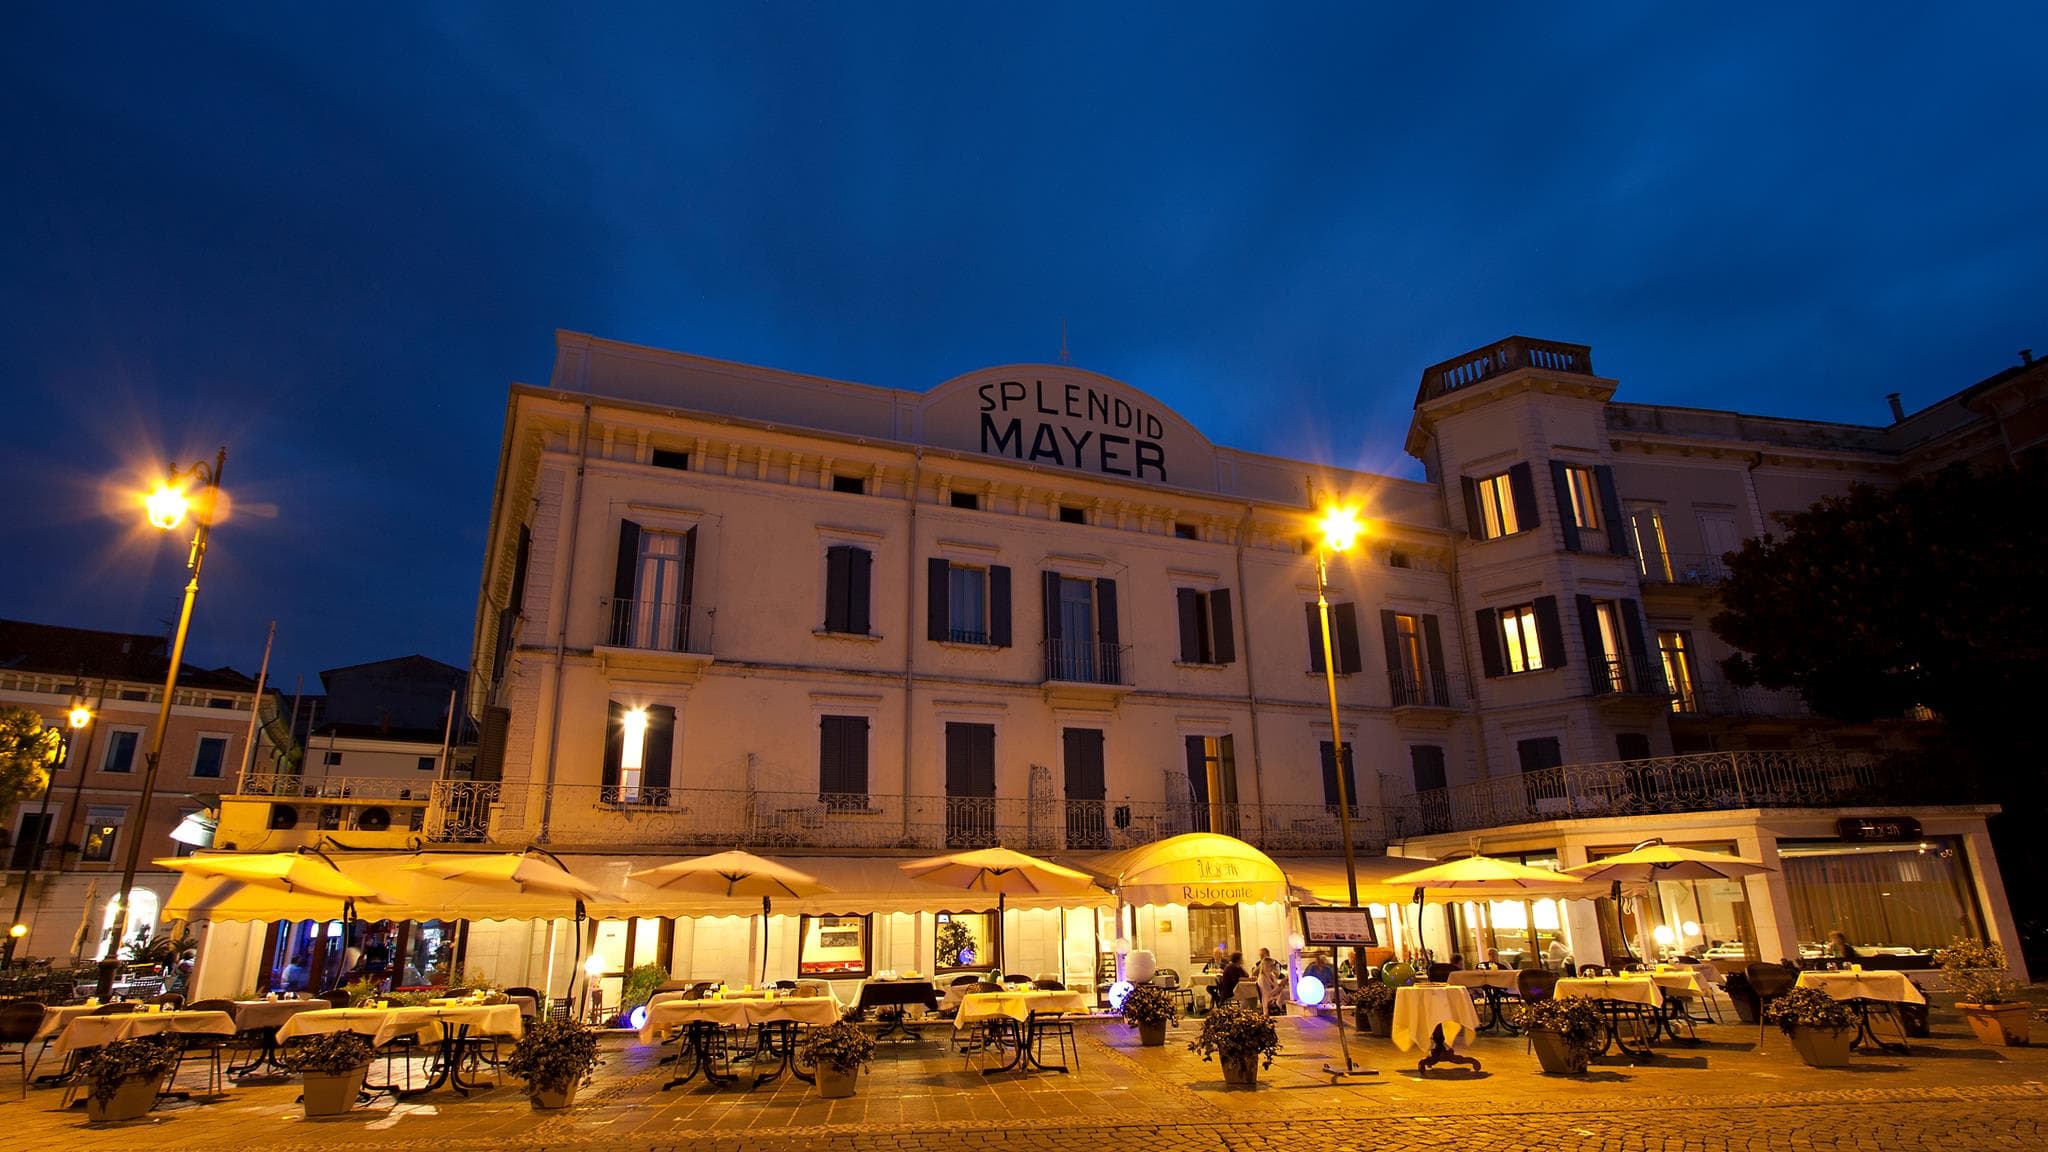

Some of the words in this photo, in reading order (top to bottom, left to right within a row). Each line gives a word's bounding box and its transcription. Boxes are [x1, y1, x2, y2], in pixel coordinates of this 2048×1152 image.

[978, 380, 1163, 440] SPLENDID
[980, 412, 1167, 482] MAYER
[1183, 885, 1253, 900] Ristorante
